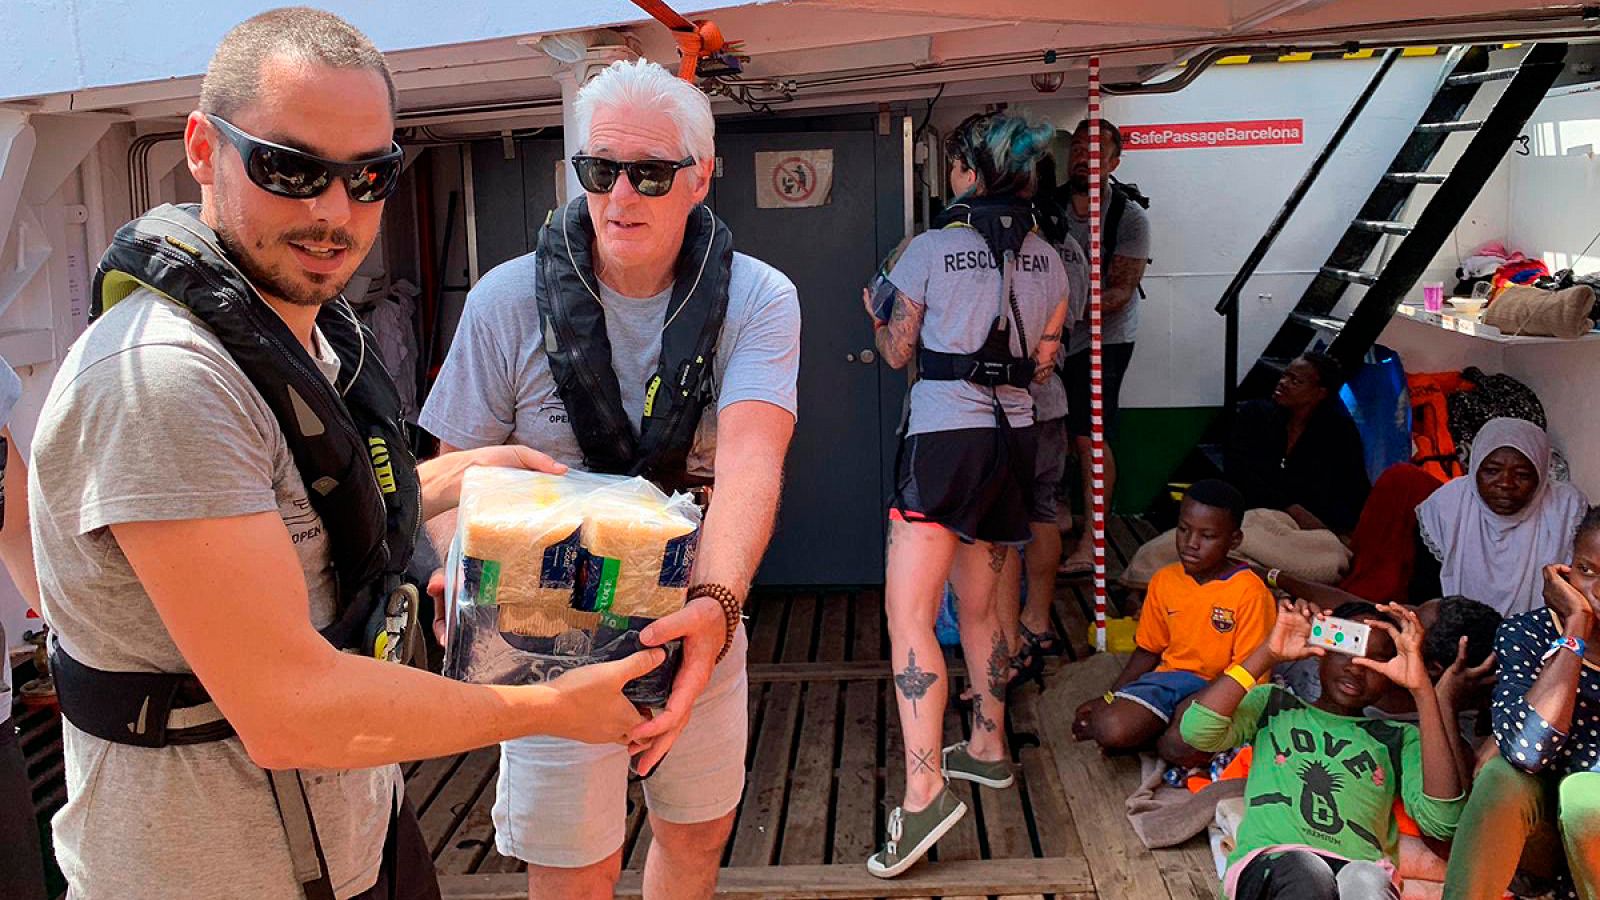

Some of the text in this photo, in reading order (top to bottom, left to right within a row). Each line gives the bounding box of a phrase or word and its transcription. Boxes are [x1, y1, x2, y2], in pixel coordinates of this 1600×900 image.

[1121, 126, 1299, 145] #SafePassageBarcelona
[549, 415, 570, 423] OPE
[1270, 727, 1378, 779] LOVE
